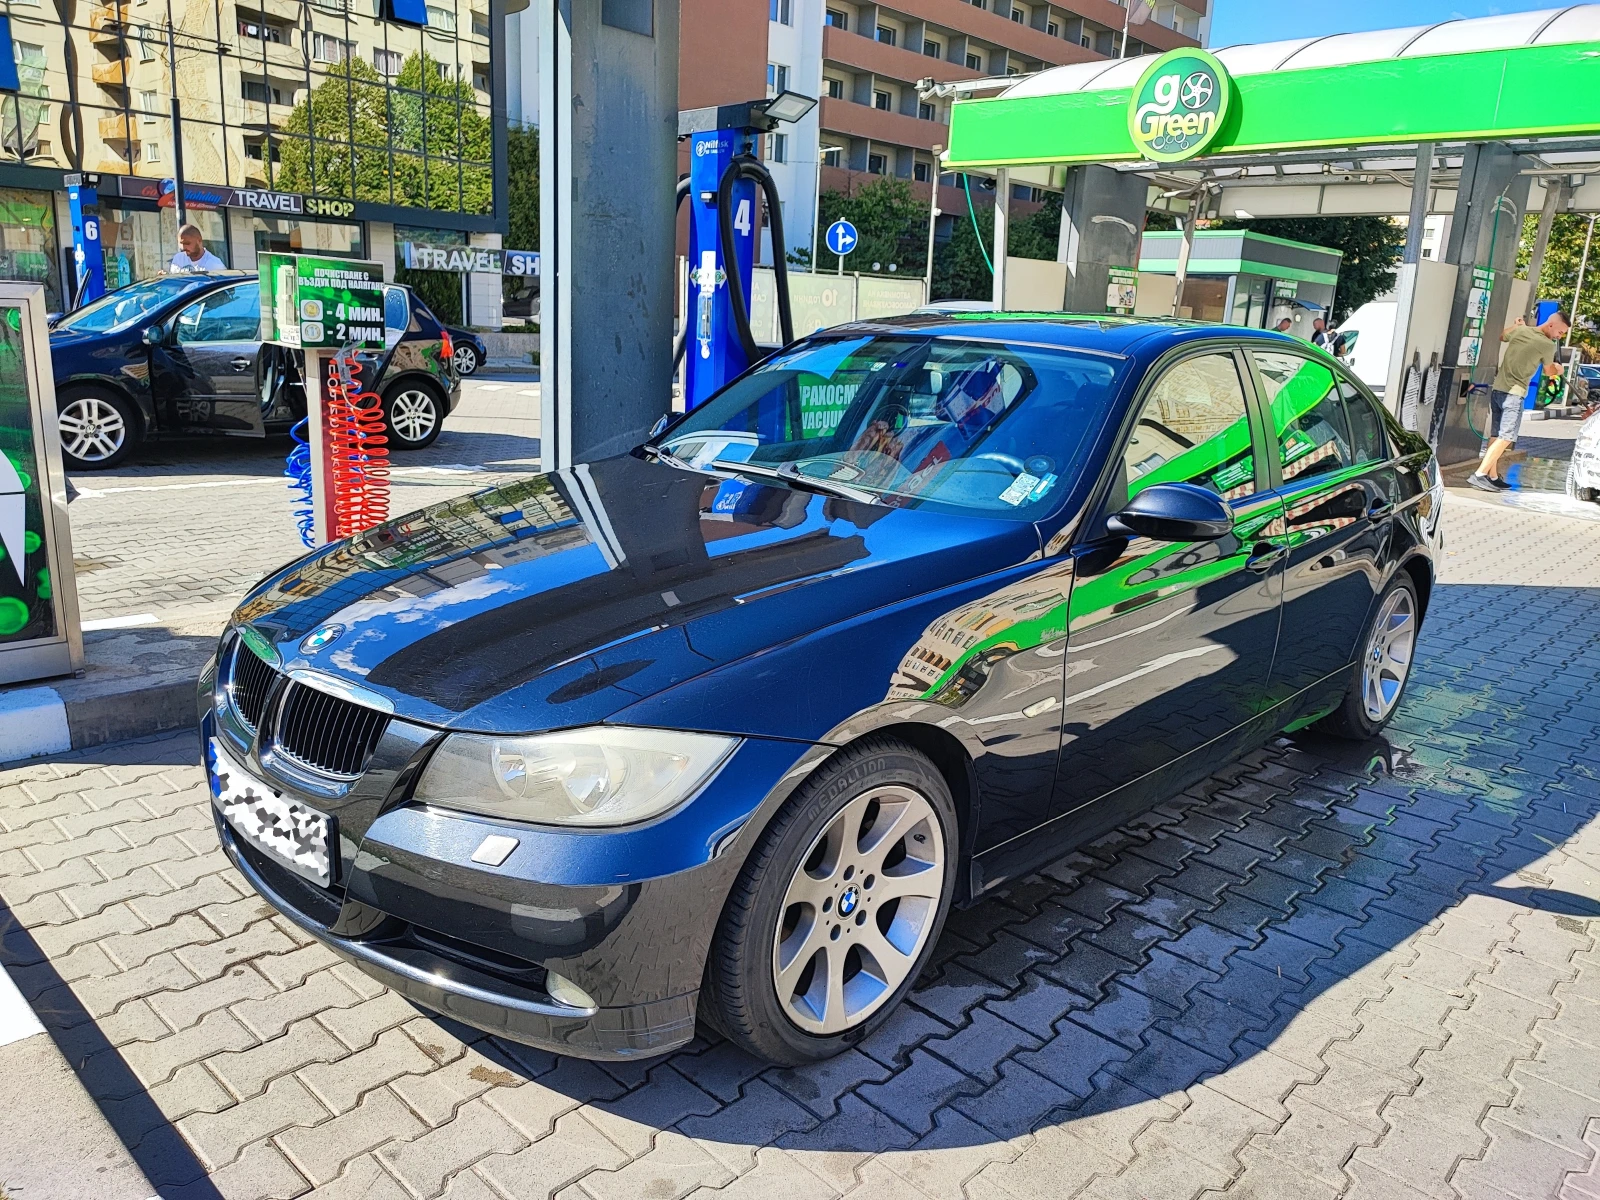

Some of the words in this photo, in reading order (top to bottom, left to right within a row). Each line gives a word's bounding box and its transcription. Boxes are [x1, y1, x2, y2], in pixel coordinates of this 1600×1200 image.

[1134, 103, 1216, 142] Green
[235, 190, 301, 212] TRAVEL
[305, 198, 355, 218] SHOP
[734, 199, 751, 237] 4
[85, 220, 98, 241] 6
[419, 247, 502, 273] TRAVEL
[298, 276, 330, 288] ВЪЗДУХ
[331, 279, 348, 290] ПОД
[348, 280, 385, 291] НАЛЯГАНЕ
[314, 268, 363, 280] ПОЧИСТВАНЕ
[335, 303, 346, 320] 4
[336, 323, 346, 340] 2
